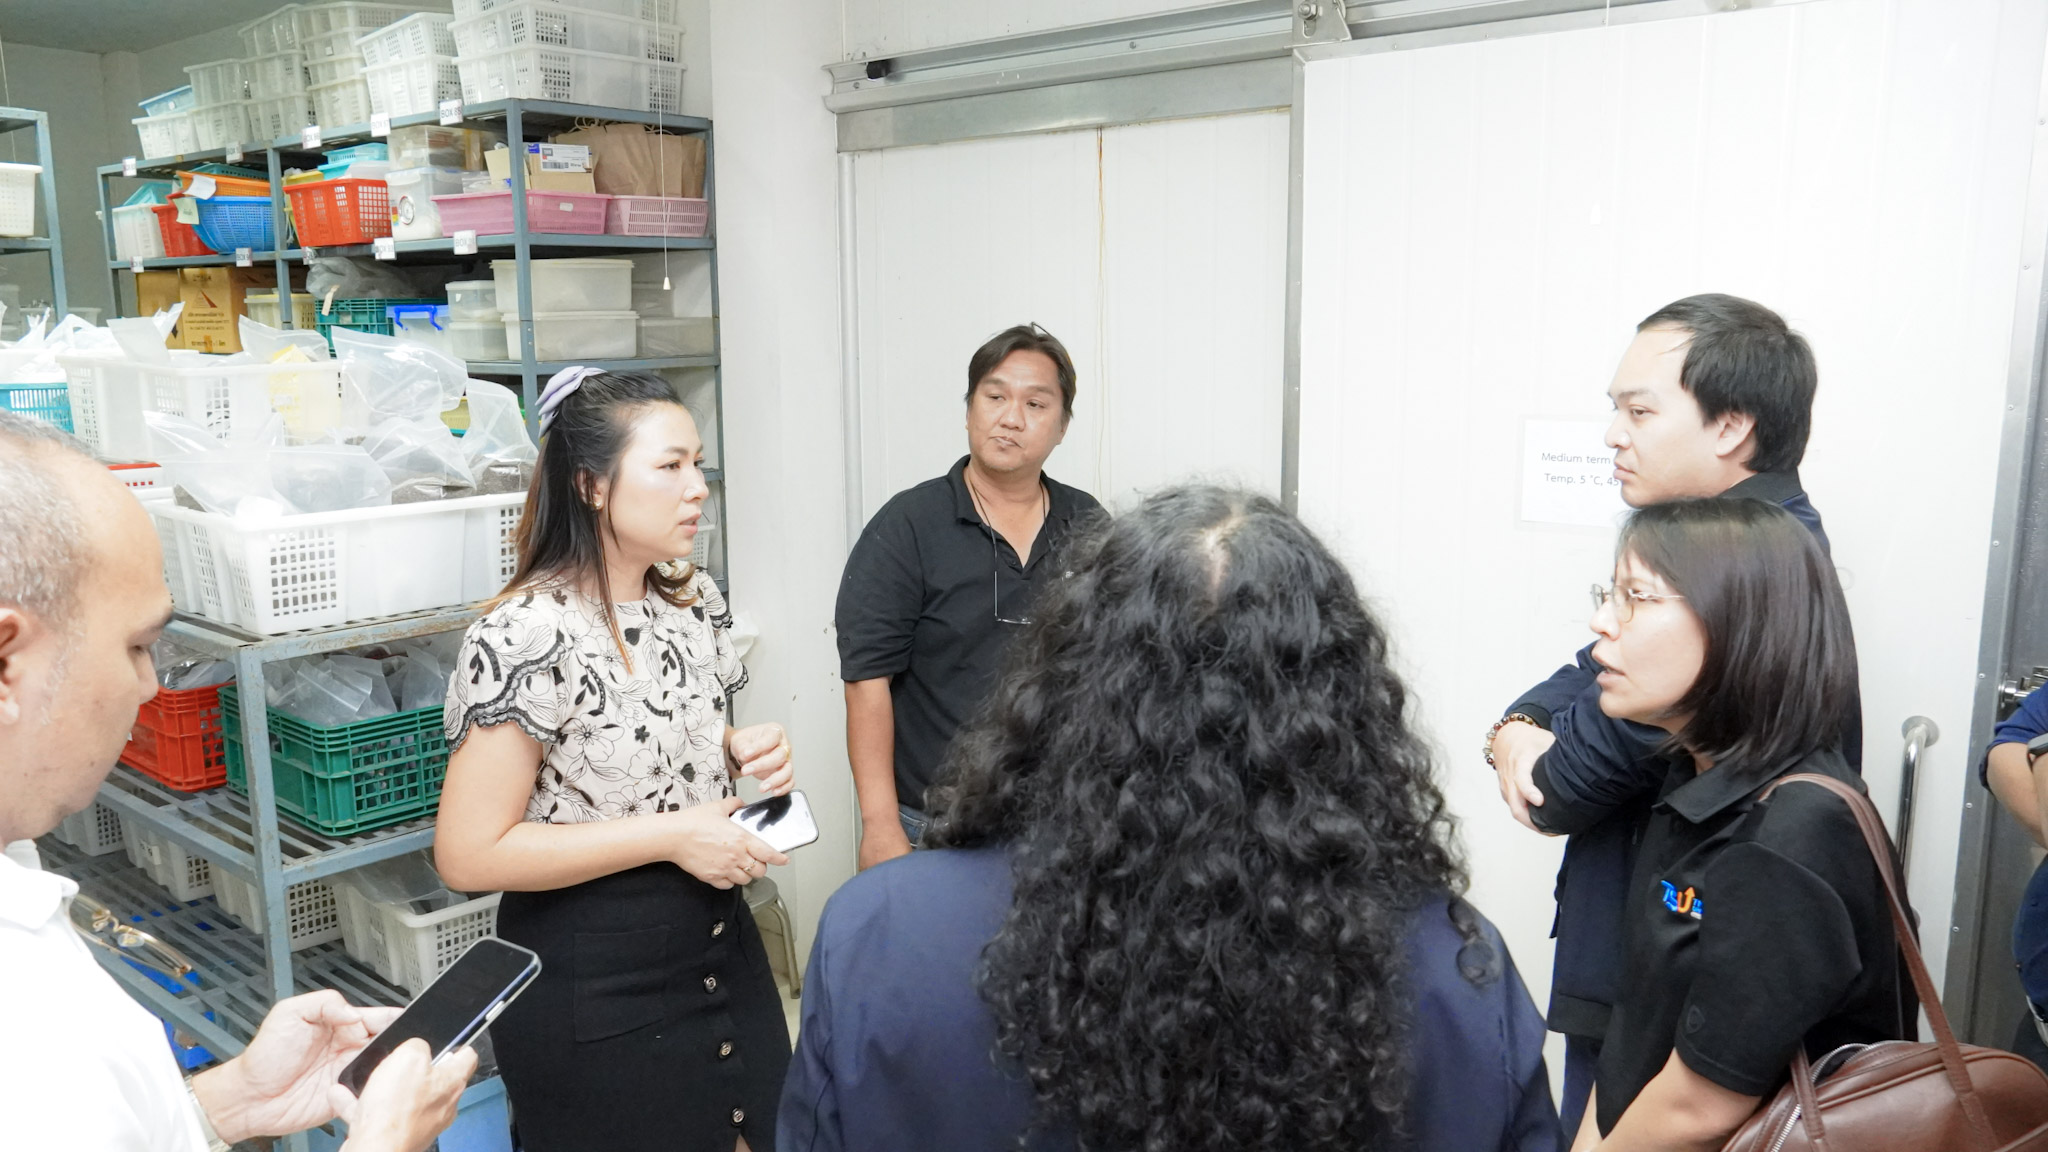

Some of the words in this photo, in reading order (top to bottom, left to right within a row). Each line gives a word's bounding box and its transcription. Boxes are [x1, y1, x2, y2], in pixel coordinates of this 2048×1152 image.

[440, 109, 453, 118] BOX
[455, 238, 467, 247] BOX
[1541, 452, 1583, 463] Medium
[1586, 455, 1611, 464] term
[1544, 473, 1576, 485] Temp.
[1579, 475, 1586, 484] 5
